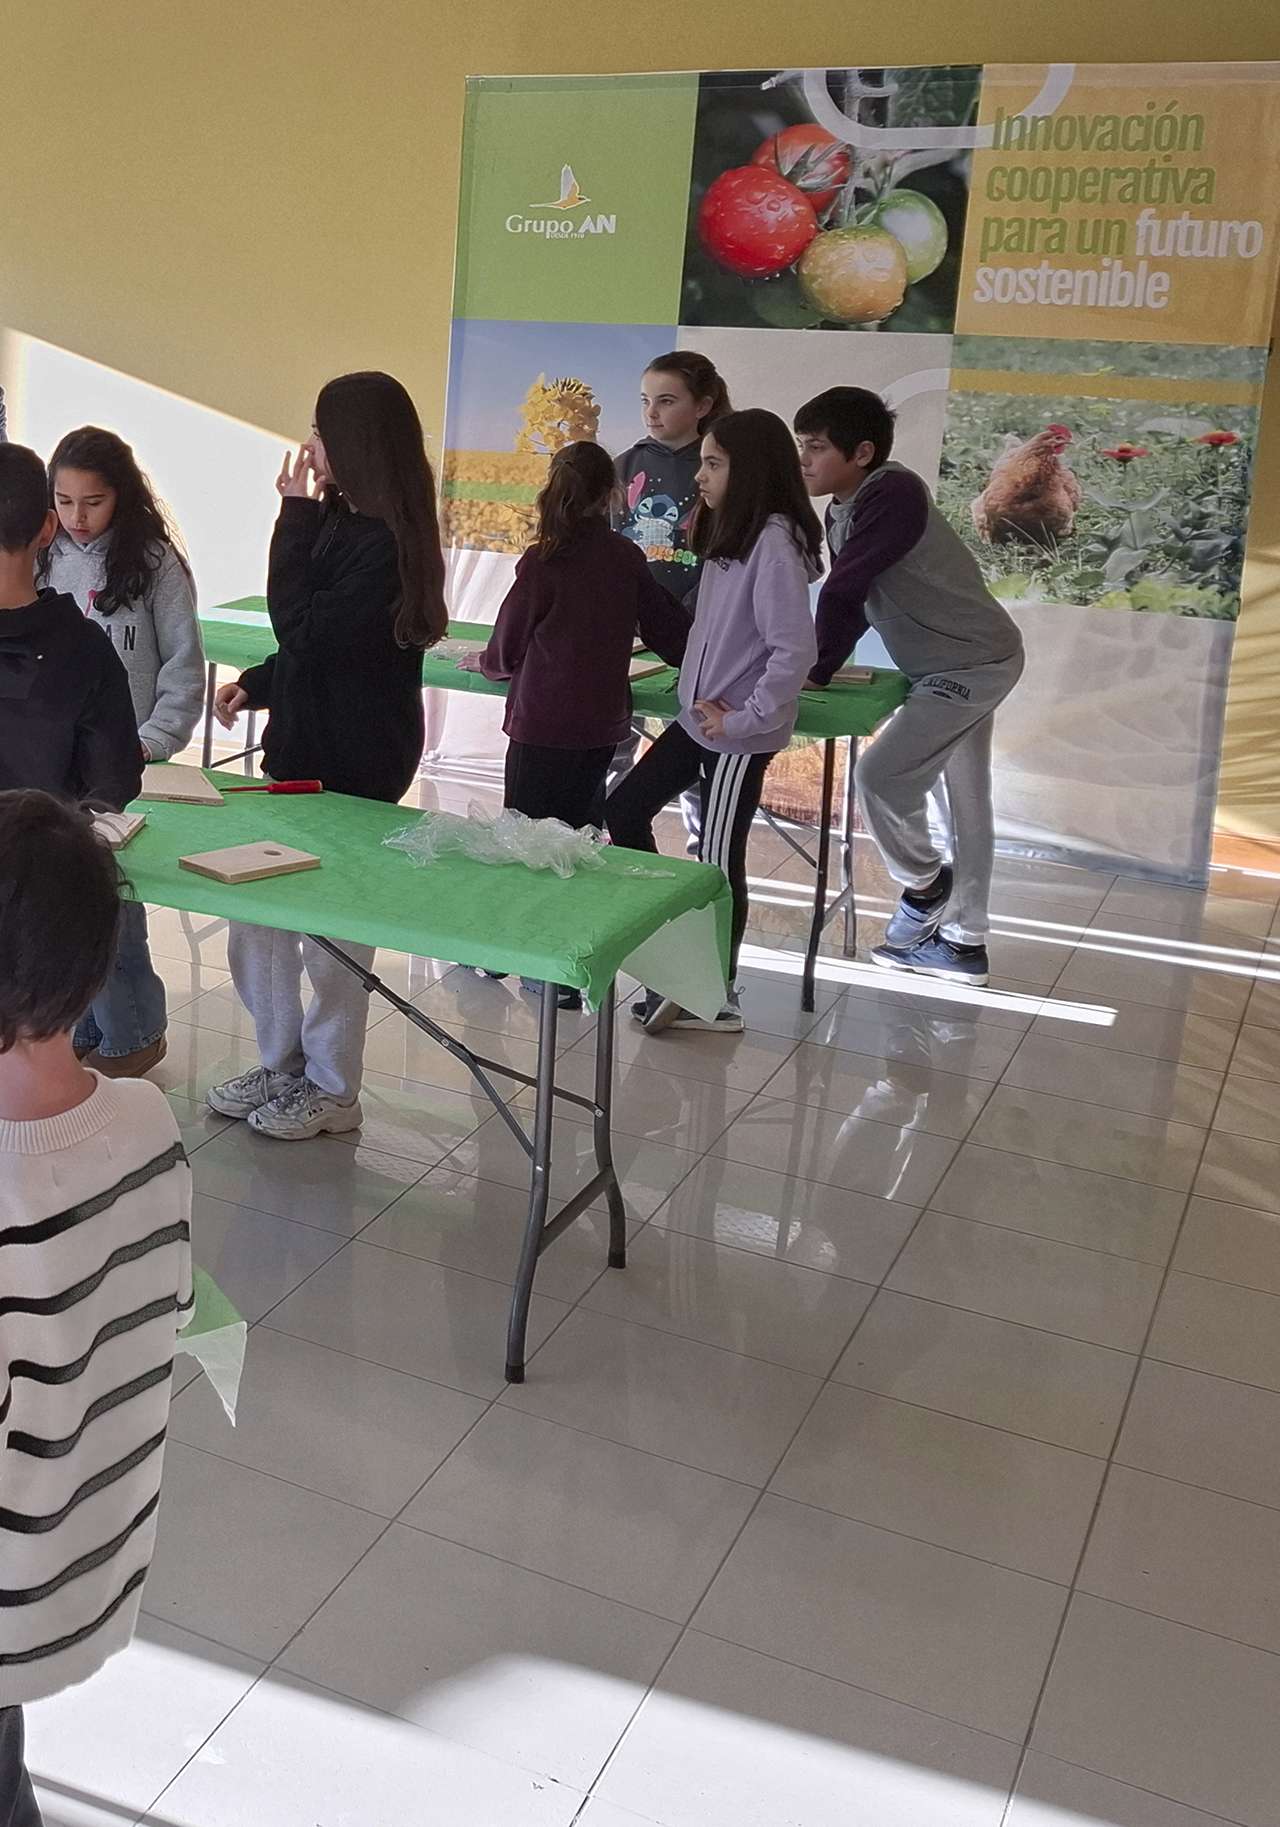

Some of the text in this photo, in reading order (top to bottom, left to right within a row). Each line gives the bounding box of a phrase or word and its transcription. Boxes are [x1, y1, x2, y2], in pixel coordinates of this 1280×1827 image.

[993, 100, 1205, 151] Innovación
[986, 154, 1216, 213] cooperativa
[505, 214, 616, 239] Grupo AN
[979, 208, 1263, 262] para un futuro
[974, 257, 1170, 308] sostenible
